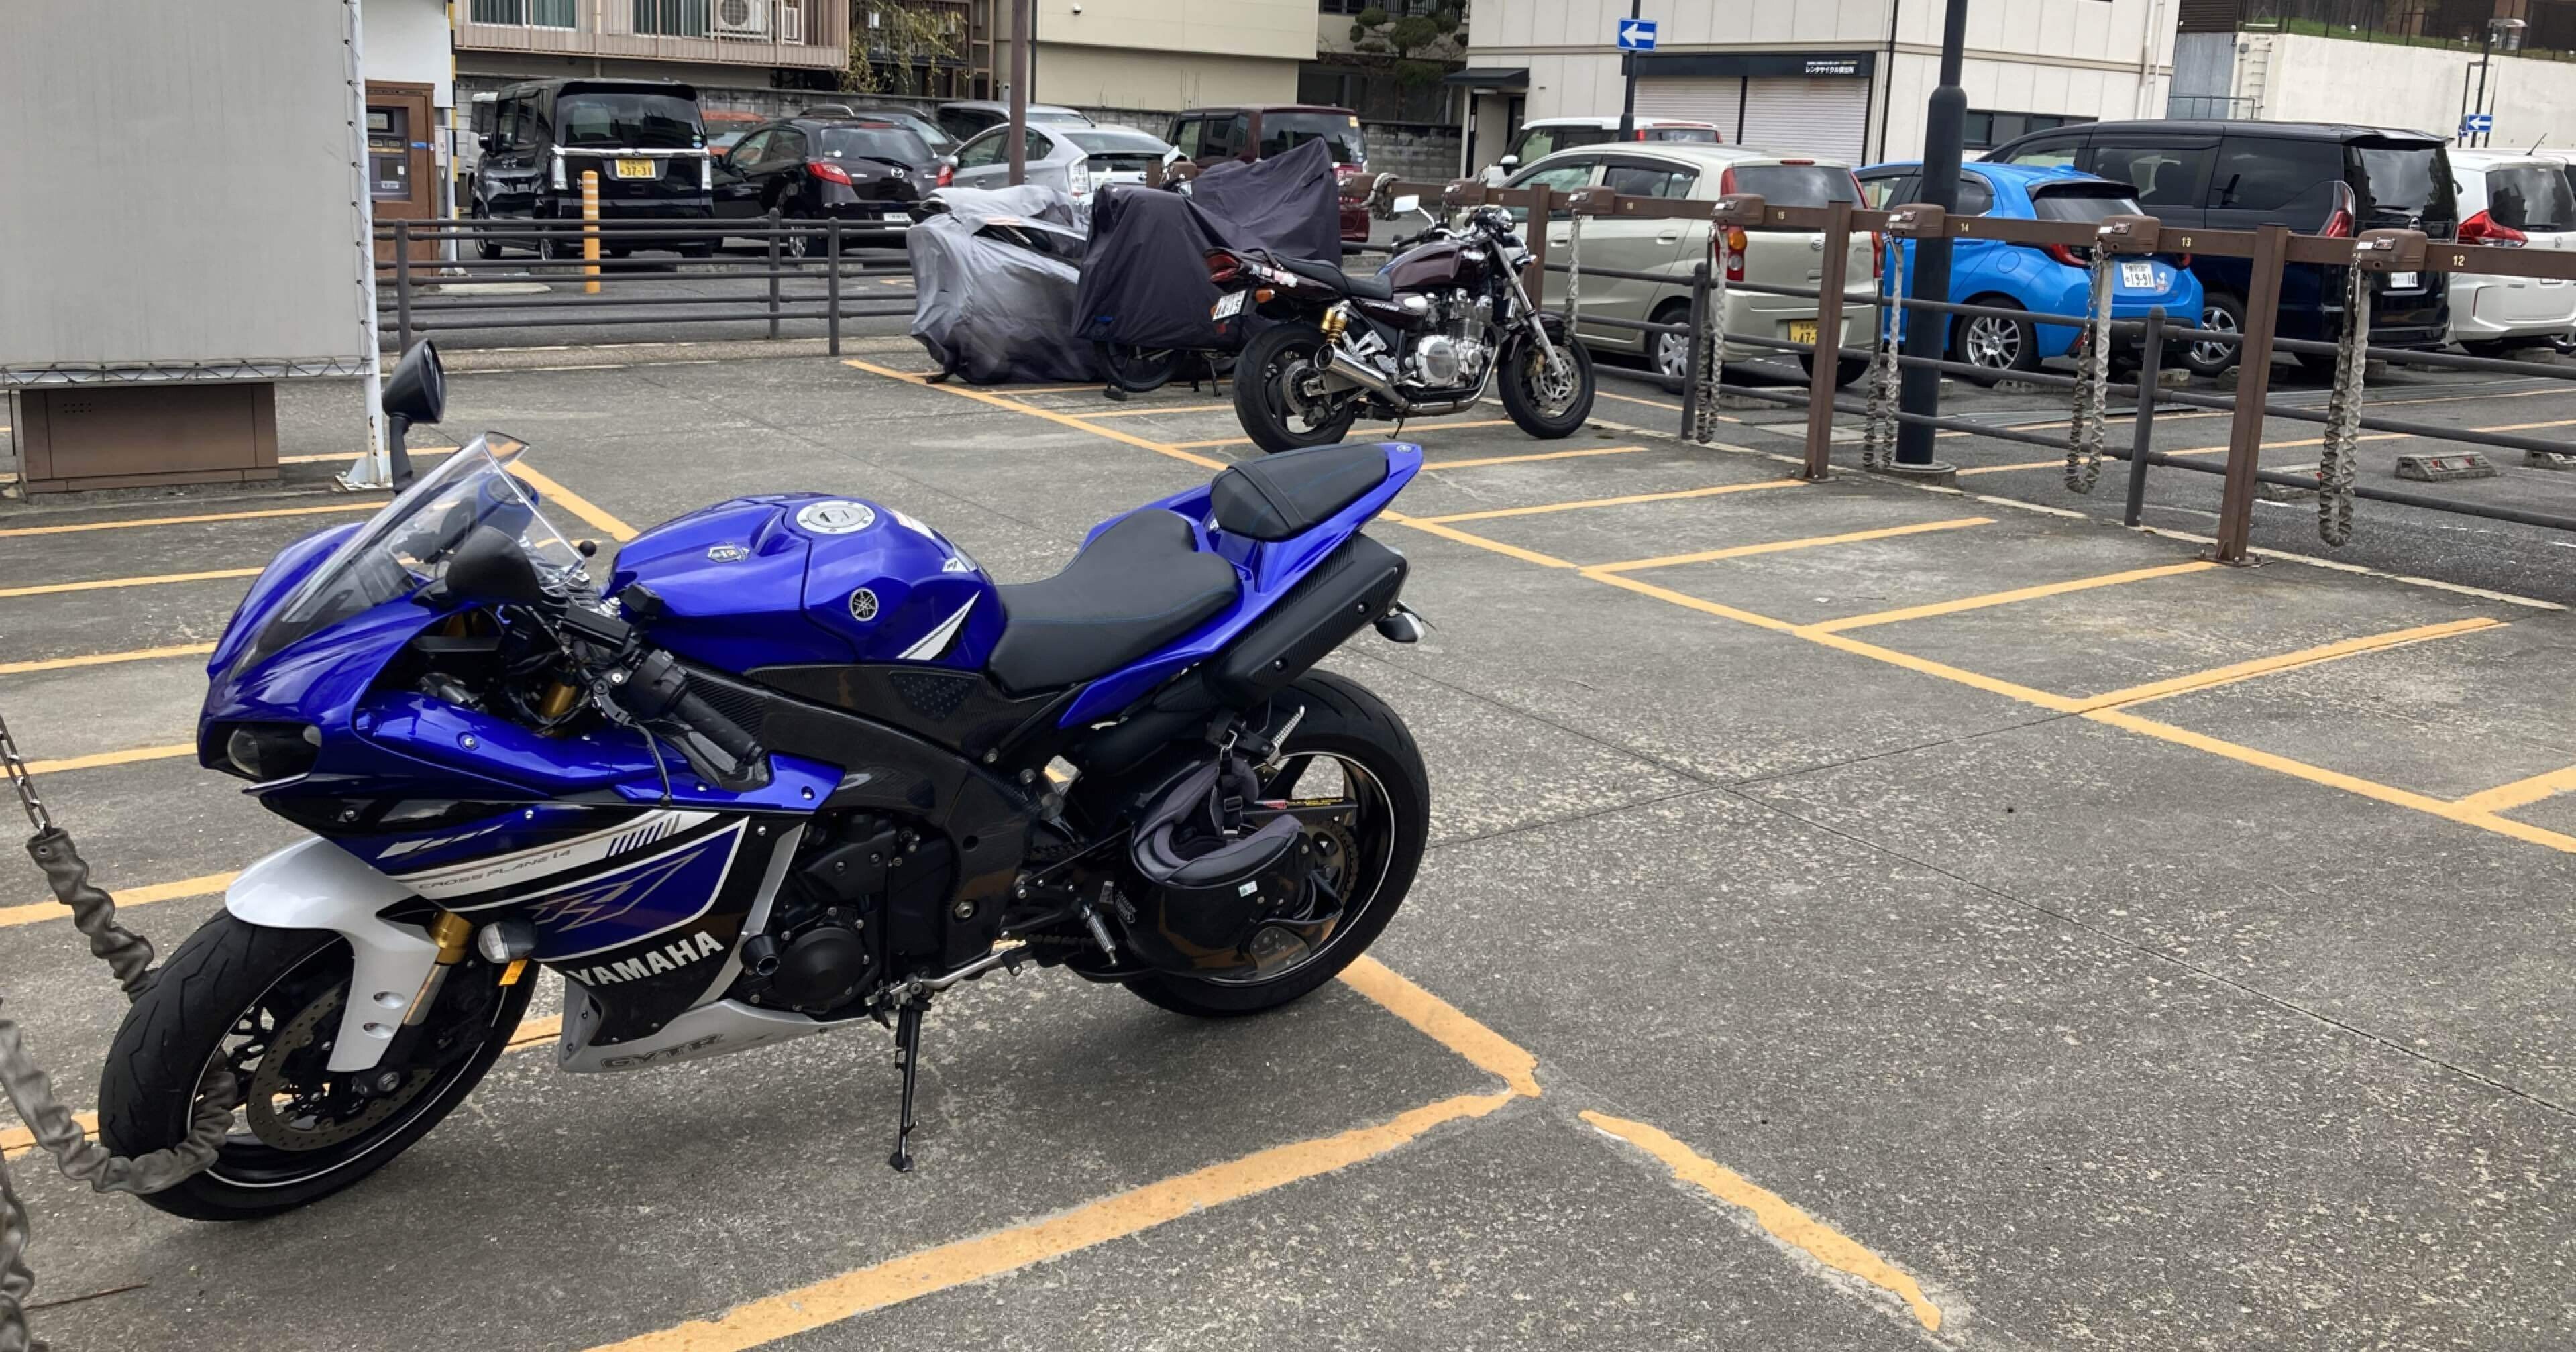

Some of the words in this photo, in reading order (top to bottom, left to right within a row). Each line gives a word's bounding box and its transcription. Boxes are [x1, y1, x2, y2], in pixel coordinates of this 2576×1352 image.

[1777, 211, 1786, 220] 15
[1961, 222, 1969, 232] 14
[2182, 236, 2192, 247] 13
[2453, 254, 2465, 266] 12
[566, 930, 724, 987] YAMAHA
